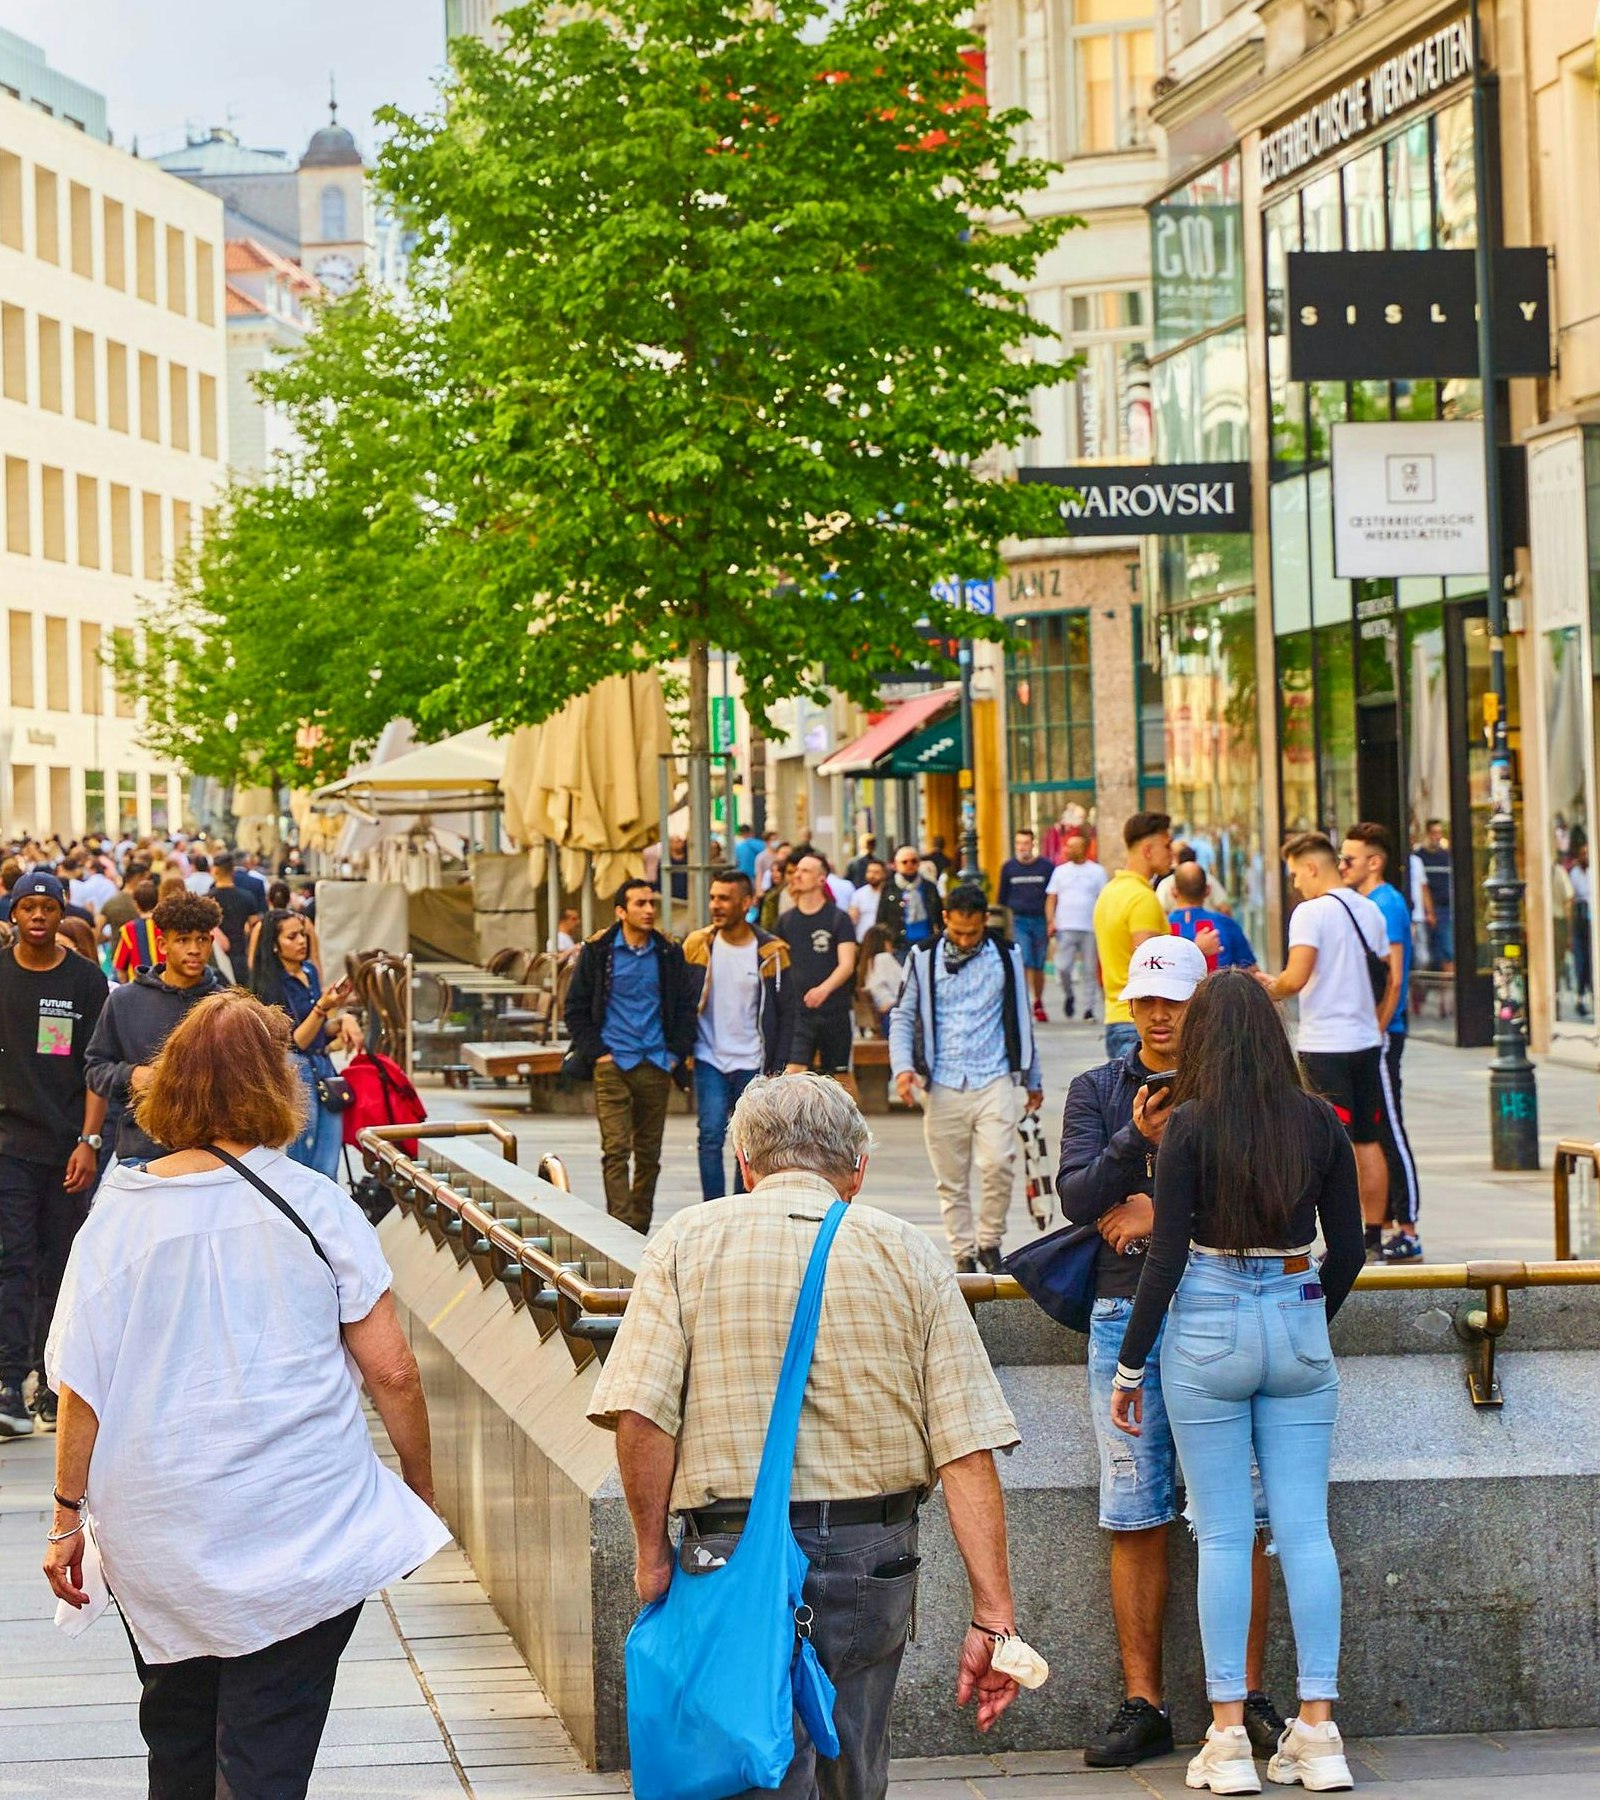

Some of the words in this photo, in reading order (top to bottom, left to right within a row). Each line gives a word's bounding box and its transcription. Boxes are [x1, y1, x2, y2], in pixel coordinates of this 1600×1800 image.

[1300, 301, 1538, 326] SISLY
[1059, 481, 1236, 519] WAROVSKI
[39, 998, 74, 1010] FUTURE
